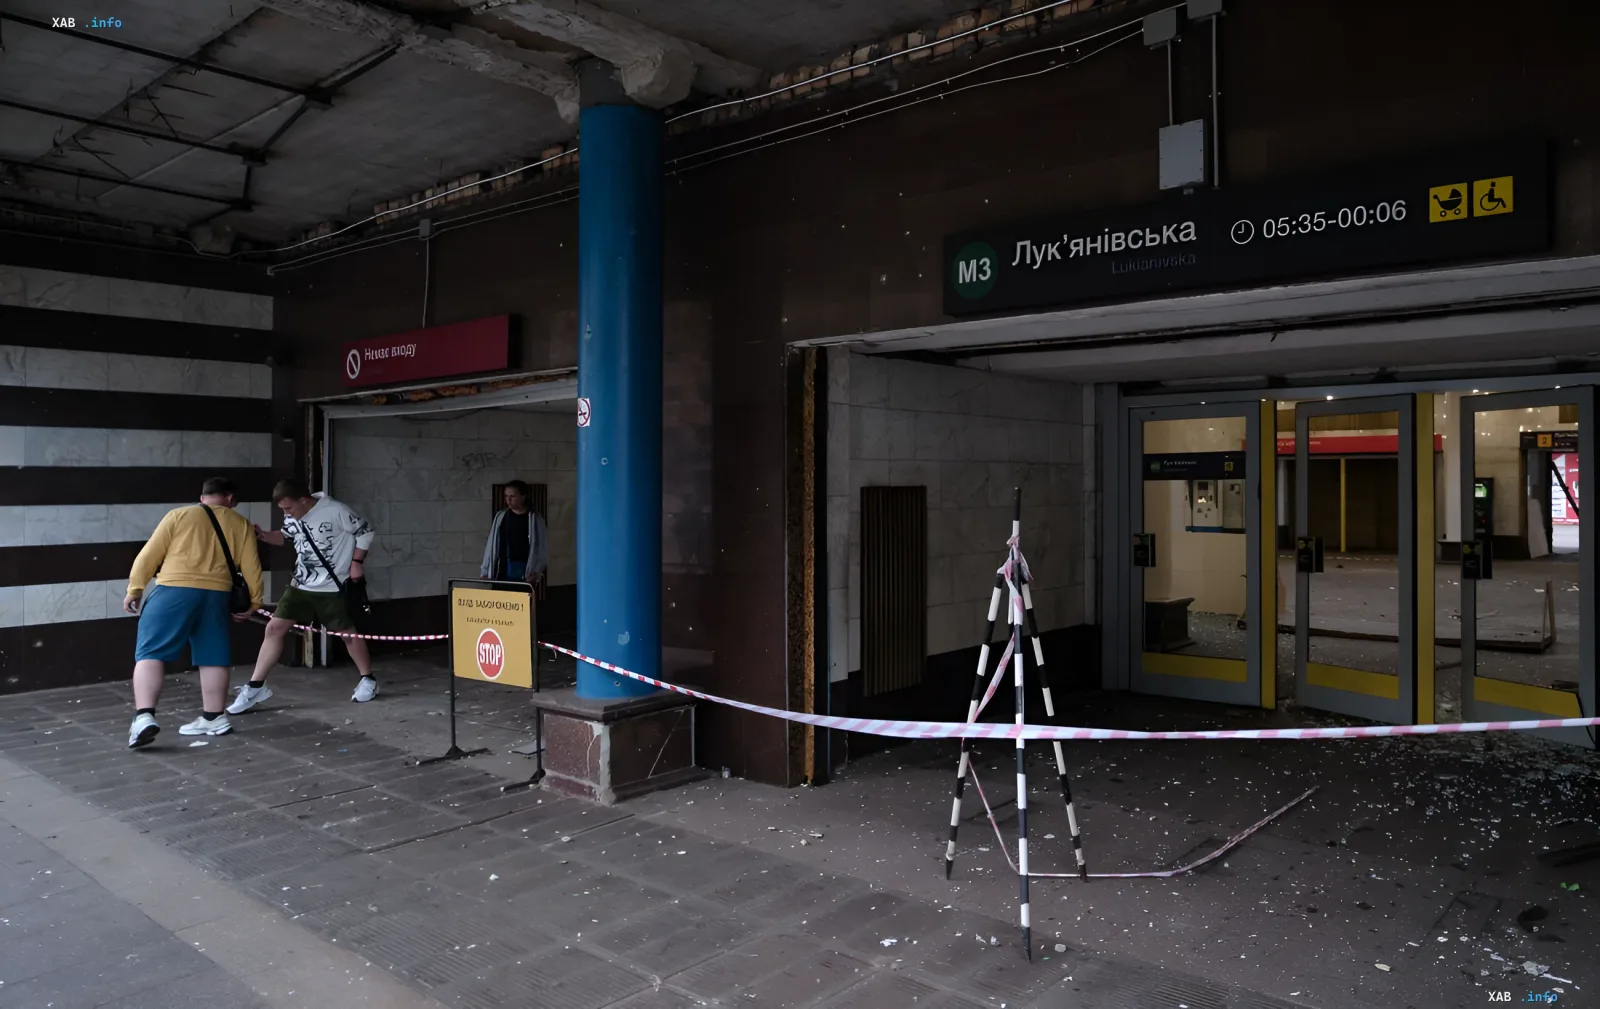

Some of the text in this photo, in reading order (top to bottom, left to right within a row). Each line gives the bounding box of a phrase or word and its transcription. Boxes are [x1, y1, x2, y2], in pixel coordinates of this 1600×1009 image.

[1262, 199, 1407, 239] 05:35-00:06
[1011, 220, 1197, 270] Лук’янівська
[958, 257, 992, 284] M3
[479, 642, 501, 666] STOP
